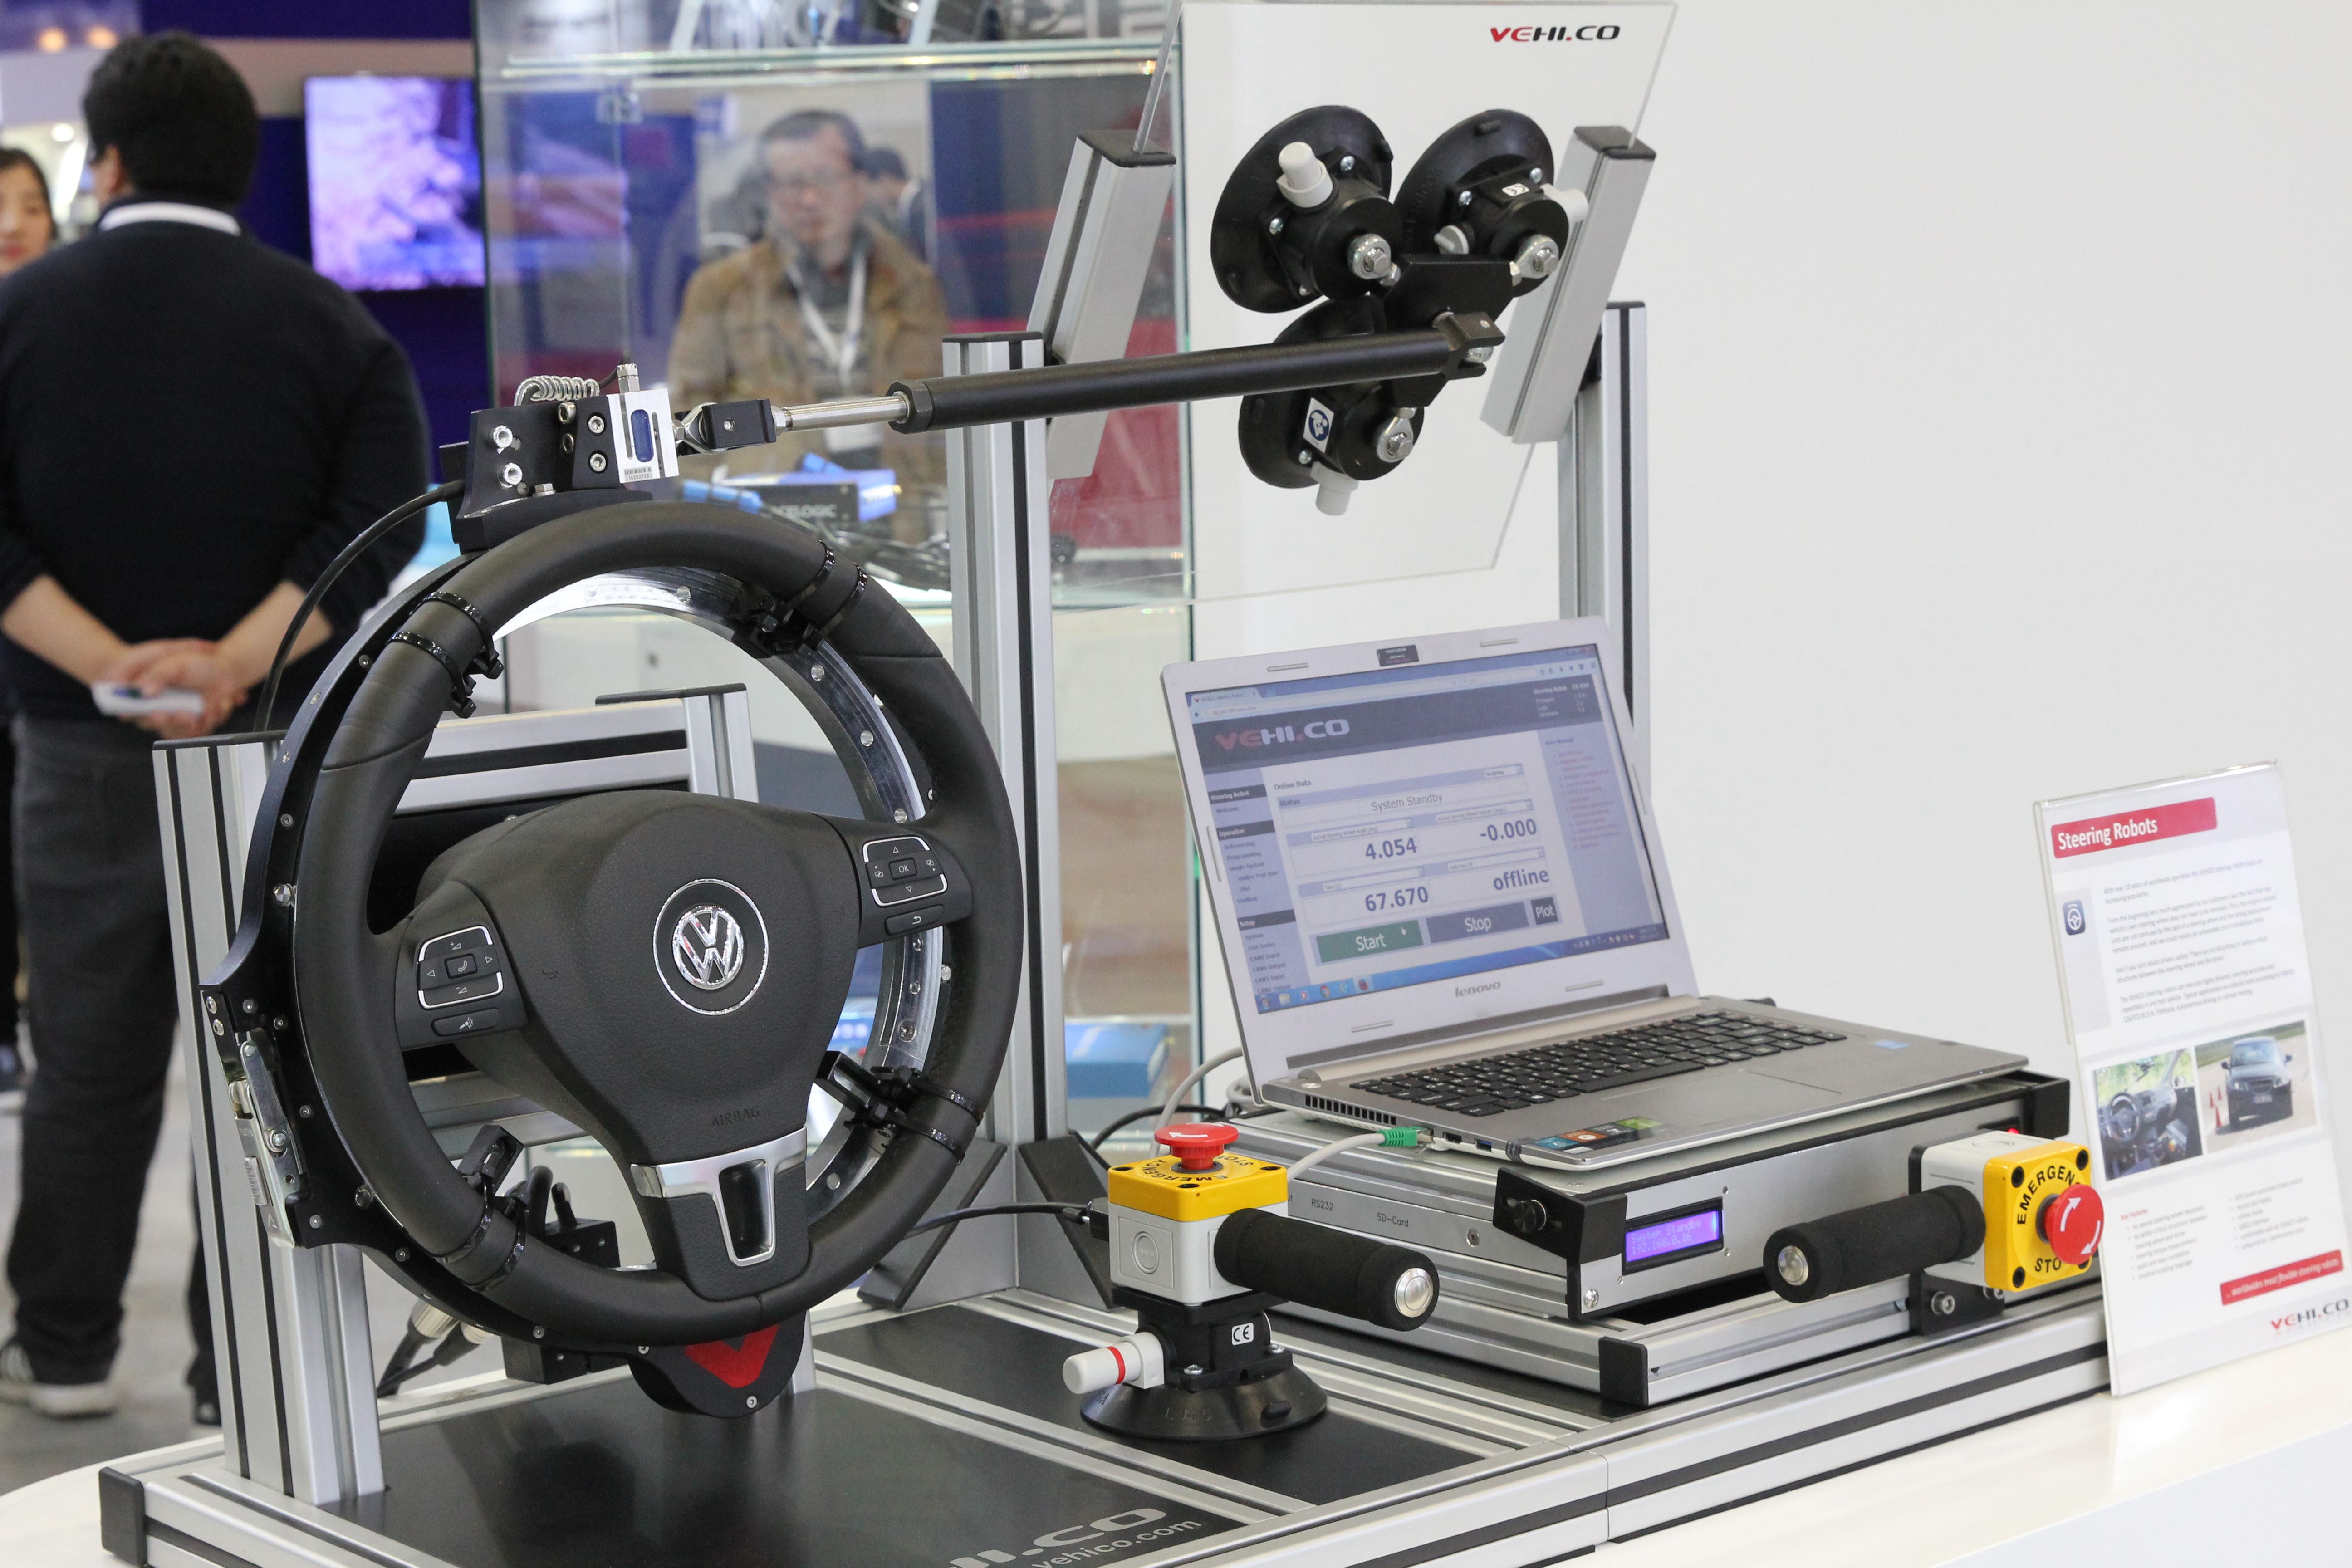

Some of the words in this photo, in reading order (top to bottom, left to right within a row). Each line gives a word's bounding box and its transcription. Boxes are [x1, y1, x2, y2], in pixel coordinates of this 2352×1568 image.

[1490, 25, 1620, 42] VEHI.CO
[1215, 718, 1350, 751] VEHI.CO
[1274, 781, 1295, 790] Online
[1295, 779, 1312, 787] Data
[1279, 798, 1301, 807] Status
[1371, 798, 1405, 813] System
[1406, 791, 1444, 808] Standby
[1219, 828, 1245, 838] Operation
[1478, 818, 1538, 843] -0.000
[2058, 826, 2112, 851] Steering
[2113, 818, 2158, 839] Robots
[1362, 836, 1418, 861] 4.054
[898, 864, 910, 873] OK
[1491, 865, 1550, 891] offline
[1363, 885, 1430, 912] 67.670
[1534, 904, 1555, 919] Plot
[1463, 914, 1493, 935] Stop
[1355, 932, 1387, 951] Start
[1455, 981, 1501, 998] lenovo
[712, 1106, 760, 1127] AIRBAG
[1142, 1159, 1228, 1181] EMERGENCY
[1311, 1198, 1334, 1211] RS232
[2017, 1165, 2080, 1225] EMERGEN
[1377, 1212, 1409, 1227] SD-Card
[1631, 1230, 1662, 1244] System
[1666, 1219, 1701, 1235] Standby
[1632, 1231, 1692, 1255] 192.168.0.16
[2034, 1258, 2062, 1273] STO
[2271, 1299, 2349, 1329] VEHI.CO
[1233, 1325, 1250, 1342] CE
